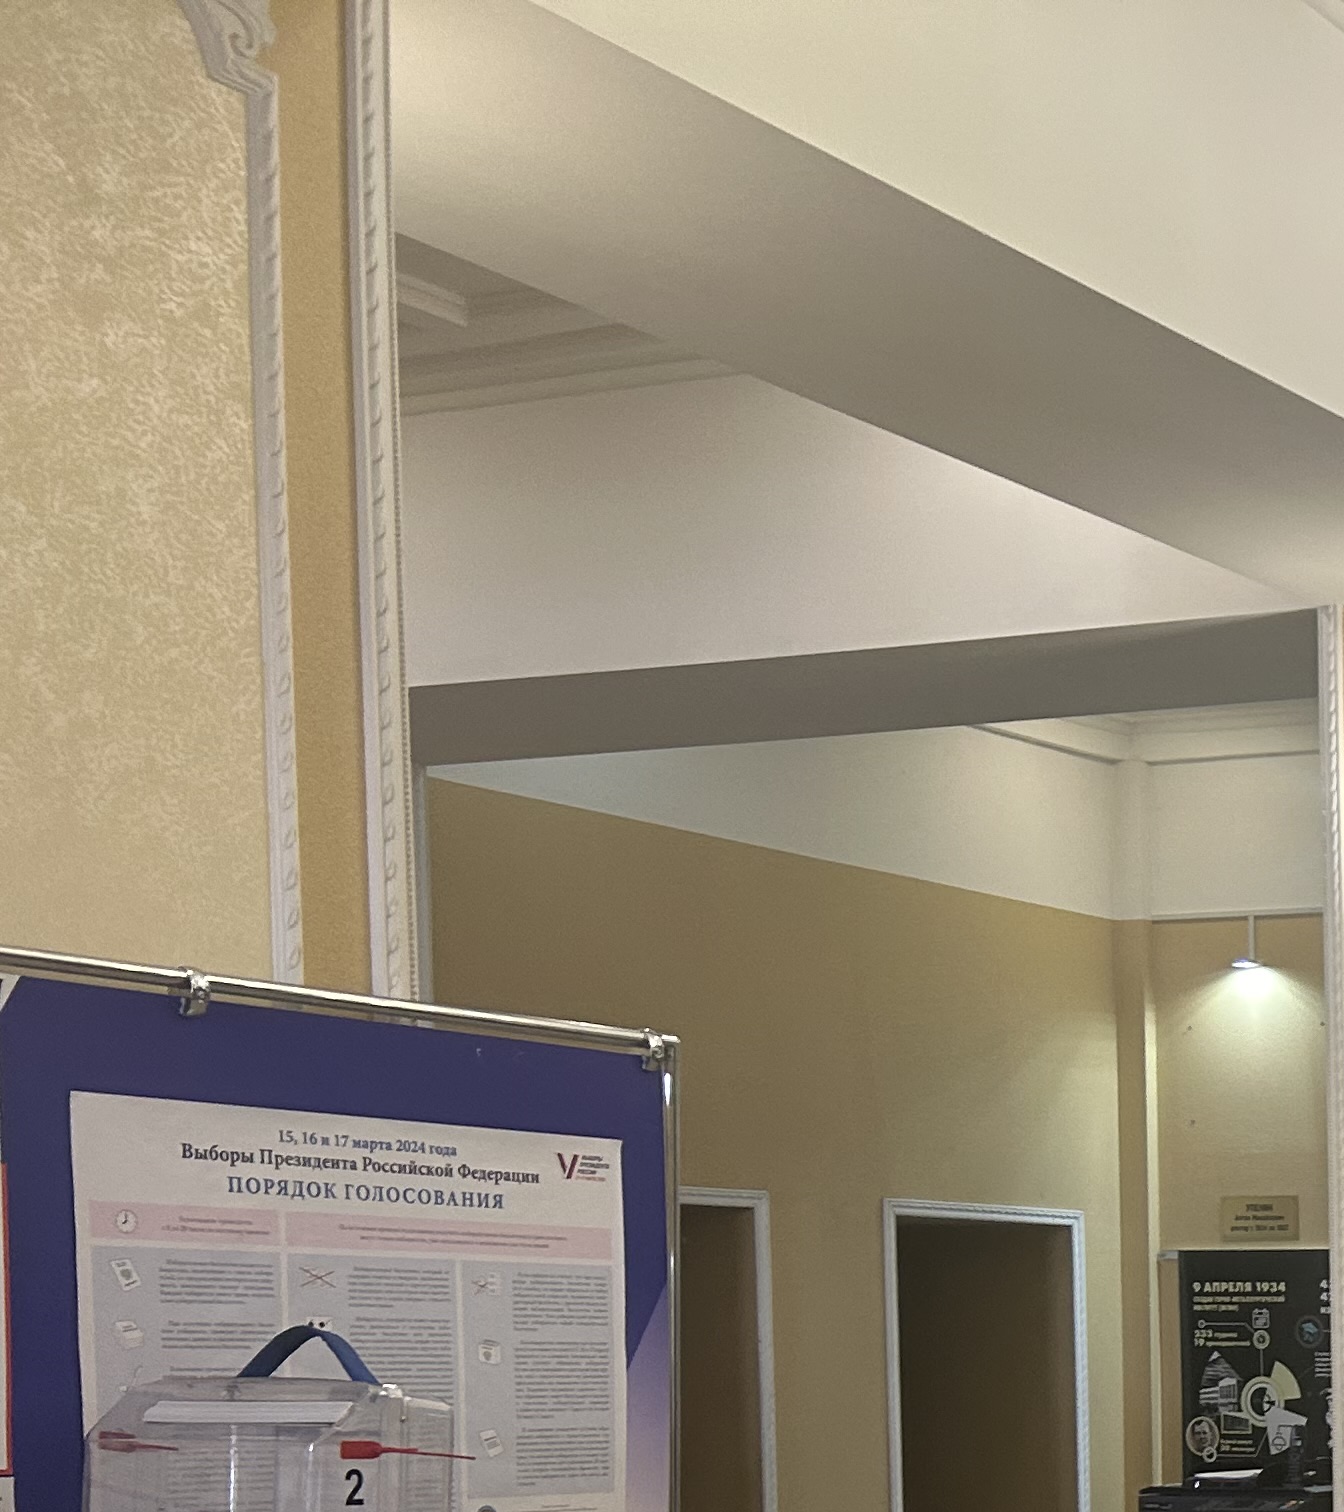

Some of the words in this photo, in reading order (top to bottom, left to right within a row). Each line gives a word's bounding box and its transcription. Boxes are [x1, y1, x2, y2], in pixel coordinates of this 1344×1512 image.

[278, 1129, 298, 1146] 15,
[302, 1131, 318, 1145] 16
[321, 1136, 331, 1147] и
[334, 1133, 350, 1147] 17
[352, 1138, 393, 1154] марта
[396, 1139, 427, 1155] 2024
[429, 1143, 458, 1159] года
[180, 1143, 255, 1167] Выборы
[259, 1149, 358, 1172] Президента
[362, 1158, 454, 1179] Российской
[457, 1163, 541, 1185] Федерации
[226, 1175, 337, 1200] ПОРЯДОК
[345, 1184, 506, 1210] ГОЛОСОВАНИЯ
[1192, 1281, 1202, 1293] 9
[1203, 1281, 1253, 1293] АПРЕЛЯ
[345, 1468, 365, 1506] 2
